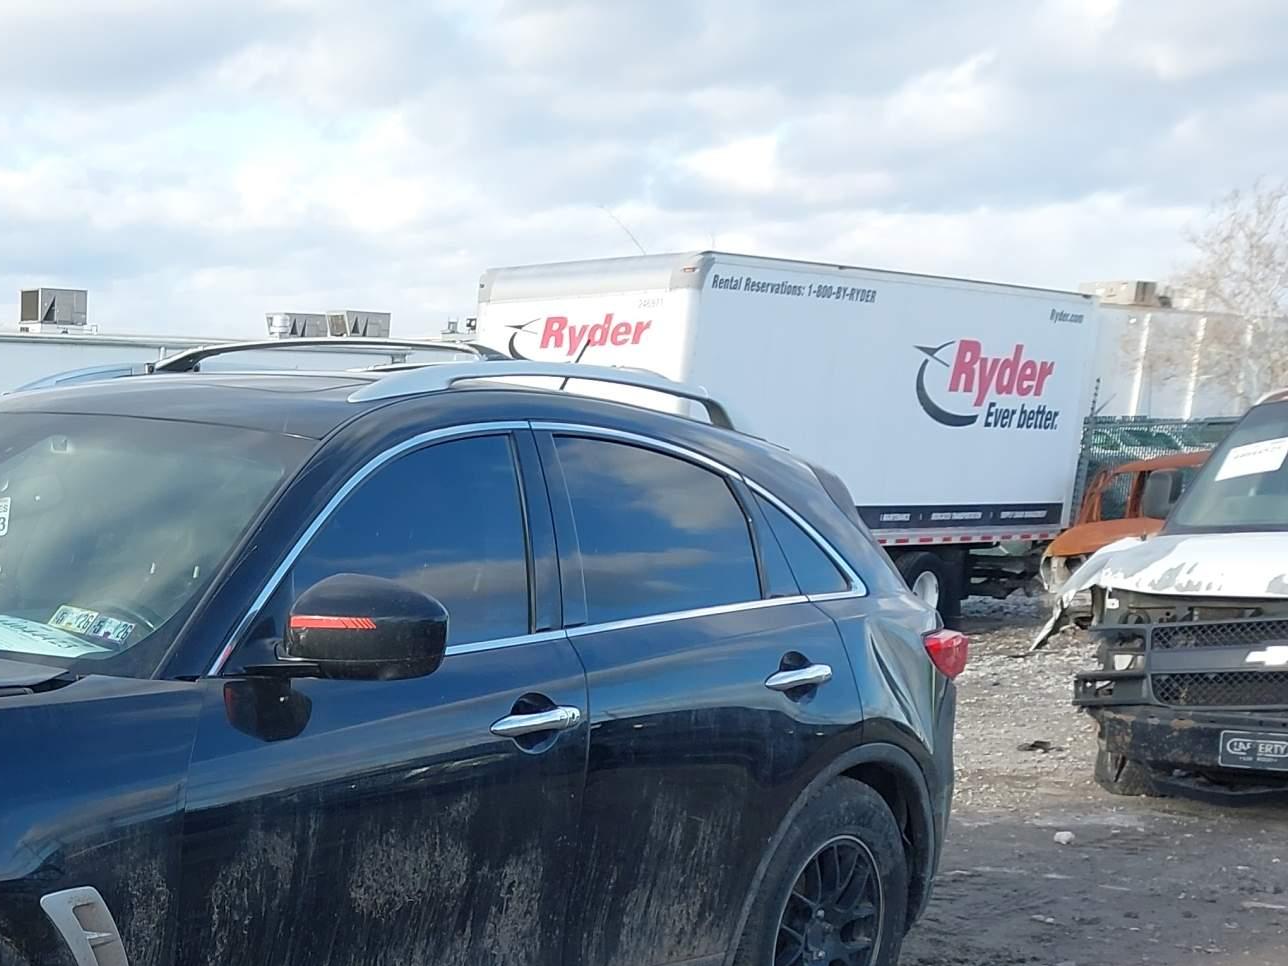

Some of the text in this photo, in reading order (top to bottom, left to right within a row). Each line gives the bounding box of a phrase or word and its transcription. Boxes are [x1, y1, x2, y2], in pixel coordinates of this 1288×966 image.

[711, 274, 877, 303] Rental Reservations: 1-800-BY-RYDER
[1049, 308, 1085, 324] Ryder.com
[539, 312, 653, 357] Ryder
[948, 339, 1055, 407] Ryder
[983, 402, 1060, 430] Ever better.
